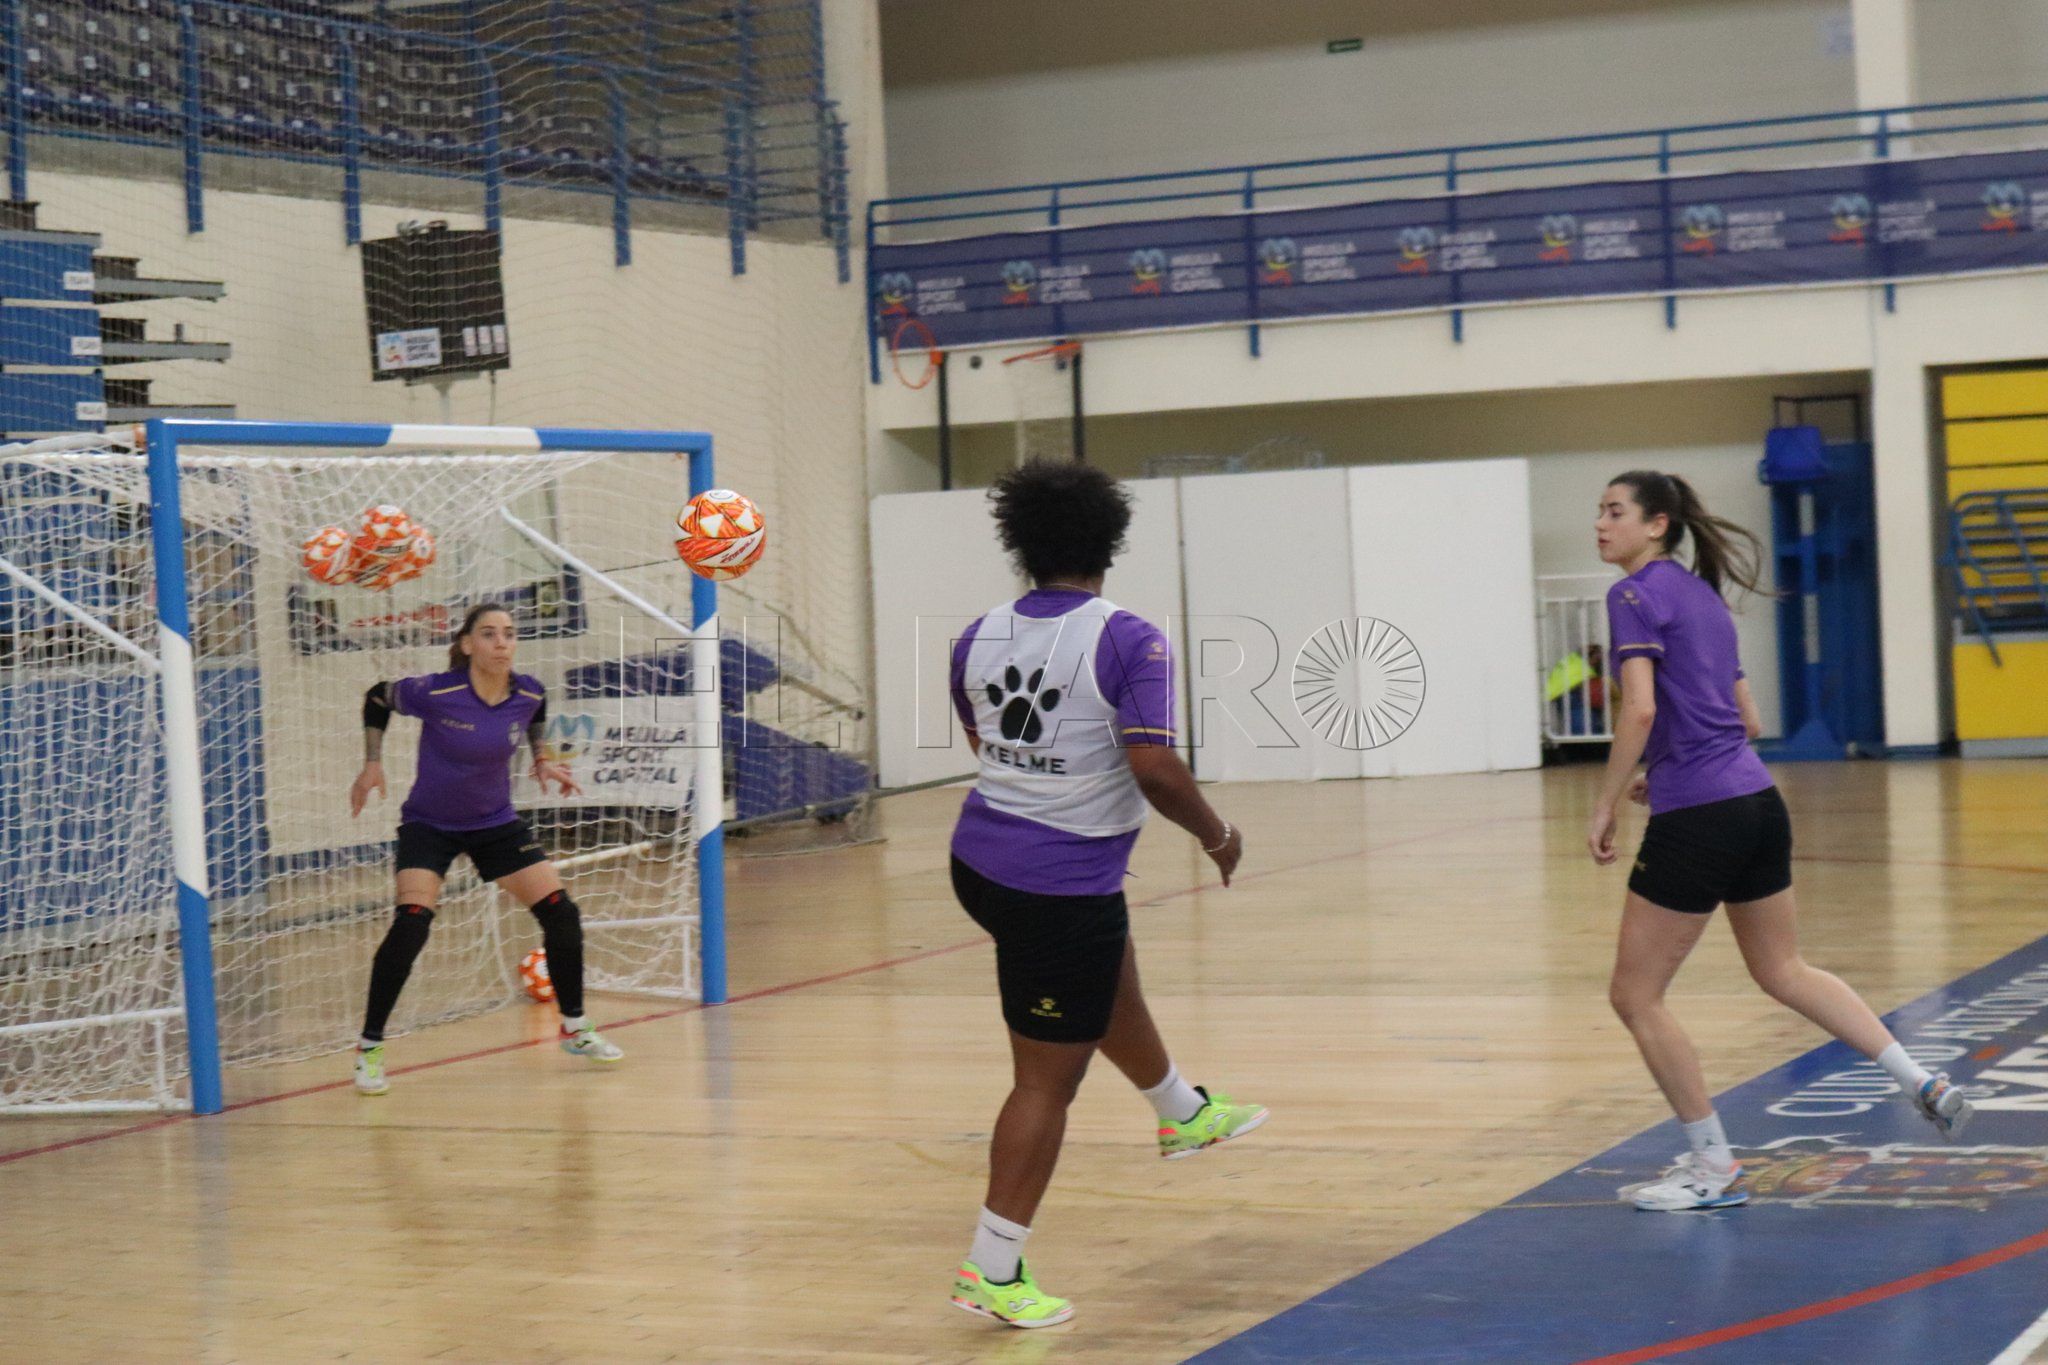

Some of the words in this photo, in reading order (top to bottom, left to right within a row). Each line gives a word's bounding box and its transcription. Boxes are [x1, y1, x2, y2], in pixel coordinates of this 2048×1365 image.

[597, 747, 669, 764] SPORT
[984, 741, 1067, 775] KELME
[593, 767, 678, 784] CAPITAL
